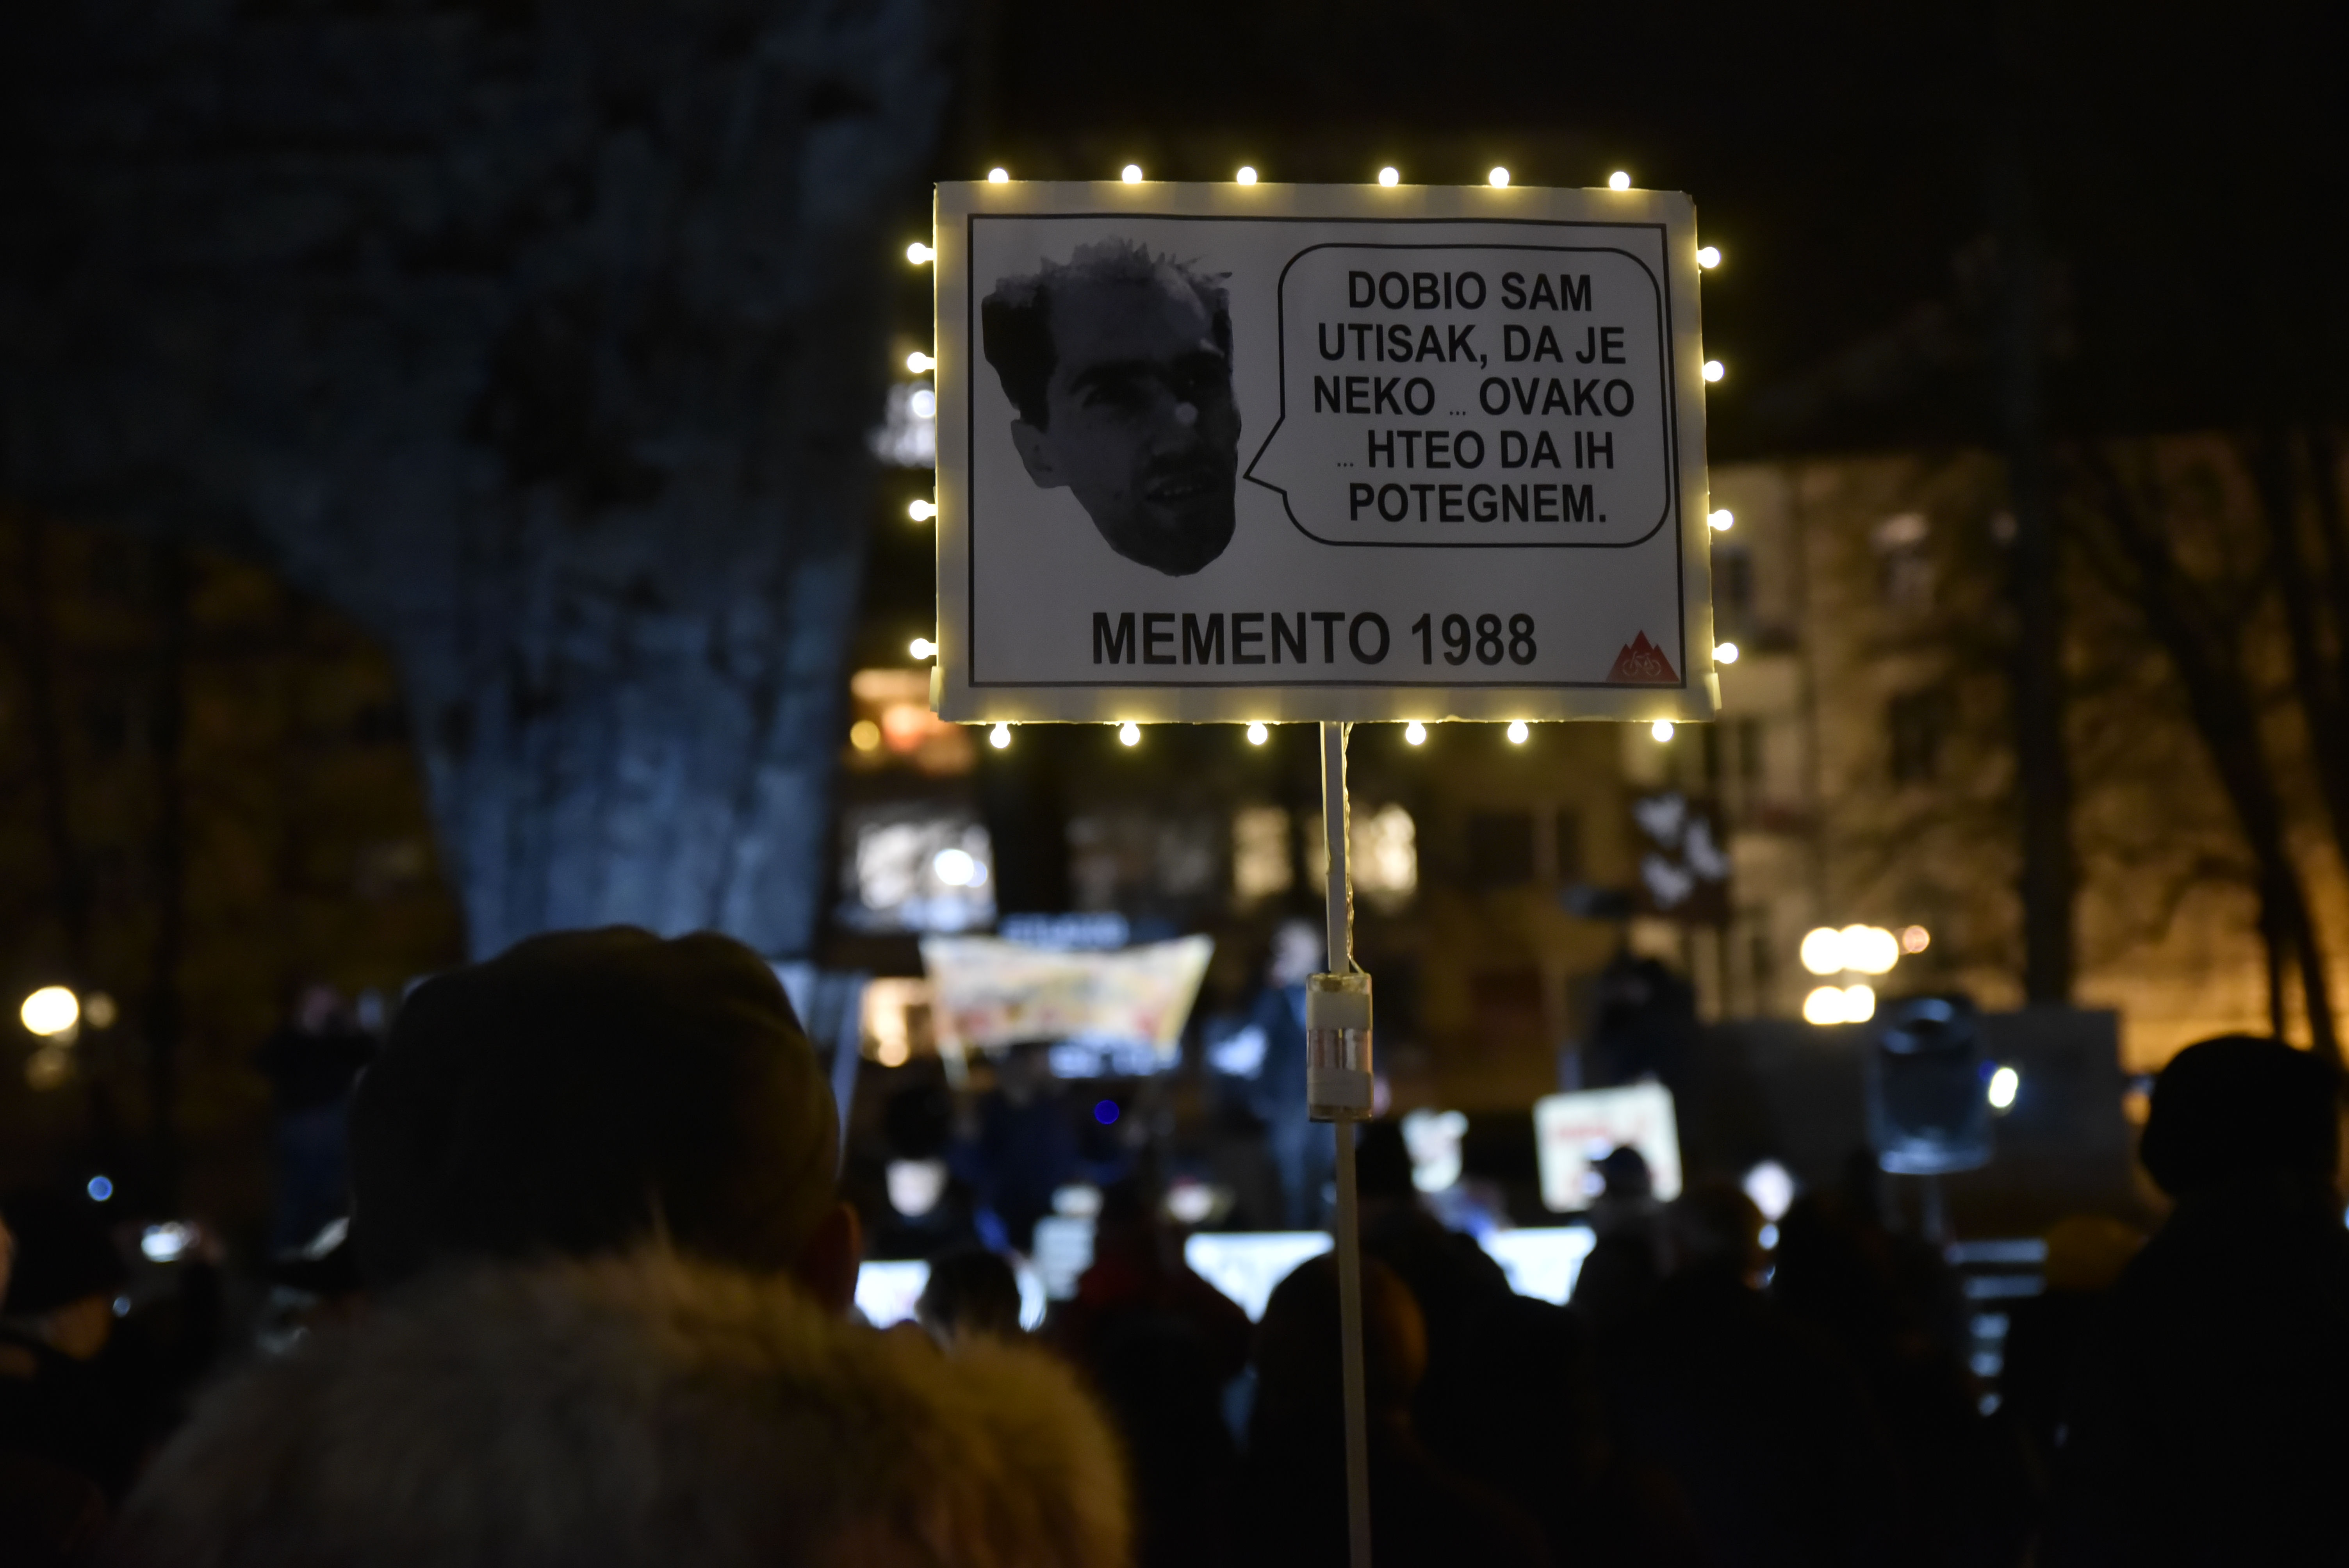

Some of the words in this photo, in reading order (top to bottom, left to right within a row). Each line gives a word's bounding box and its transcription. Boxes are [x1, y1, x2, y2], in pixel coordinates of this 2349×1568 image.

[1348, 270, 1486, 310] DOBIO
[1501, 271, 1592, 312] SAM
[1318, 322, 1487, 370] UTISAK,
[1503, 324, 1564, 363] DA
[1575, 326, 1626, 365] JE
[1314, 375, 1435, 416] NEKO
[1479, 377, 1634, 418] OVAKO
[1368, 429, 1485, 469] HTEO
[1500, 430, 1561, 469] DA
[1574, 431, 1614, 469] IH
[1349, 482, 1606, 523] POTEGNEM.
[1093, 611, 1390, 665] MEMENTO
[1412, 613, 1537, 666] 1988
